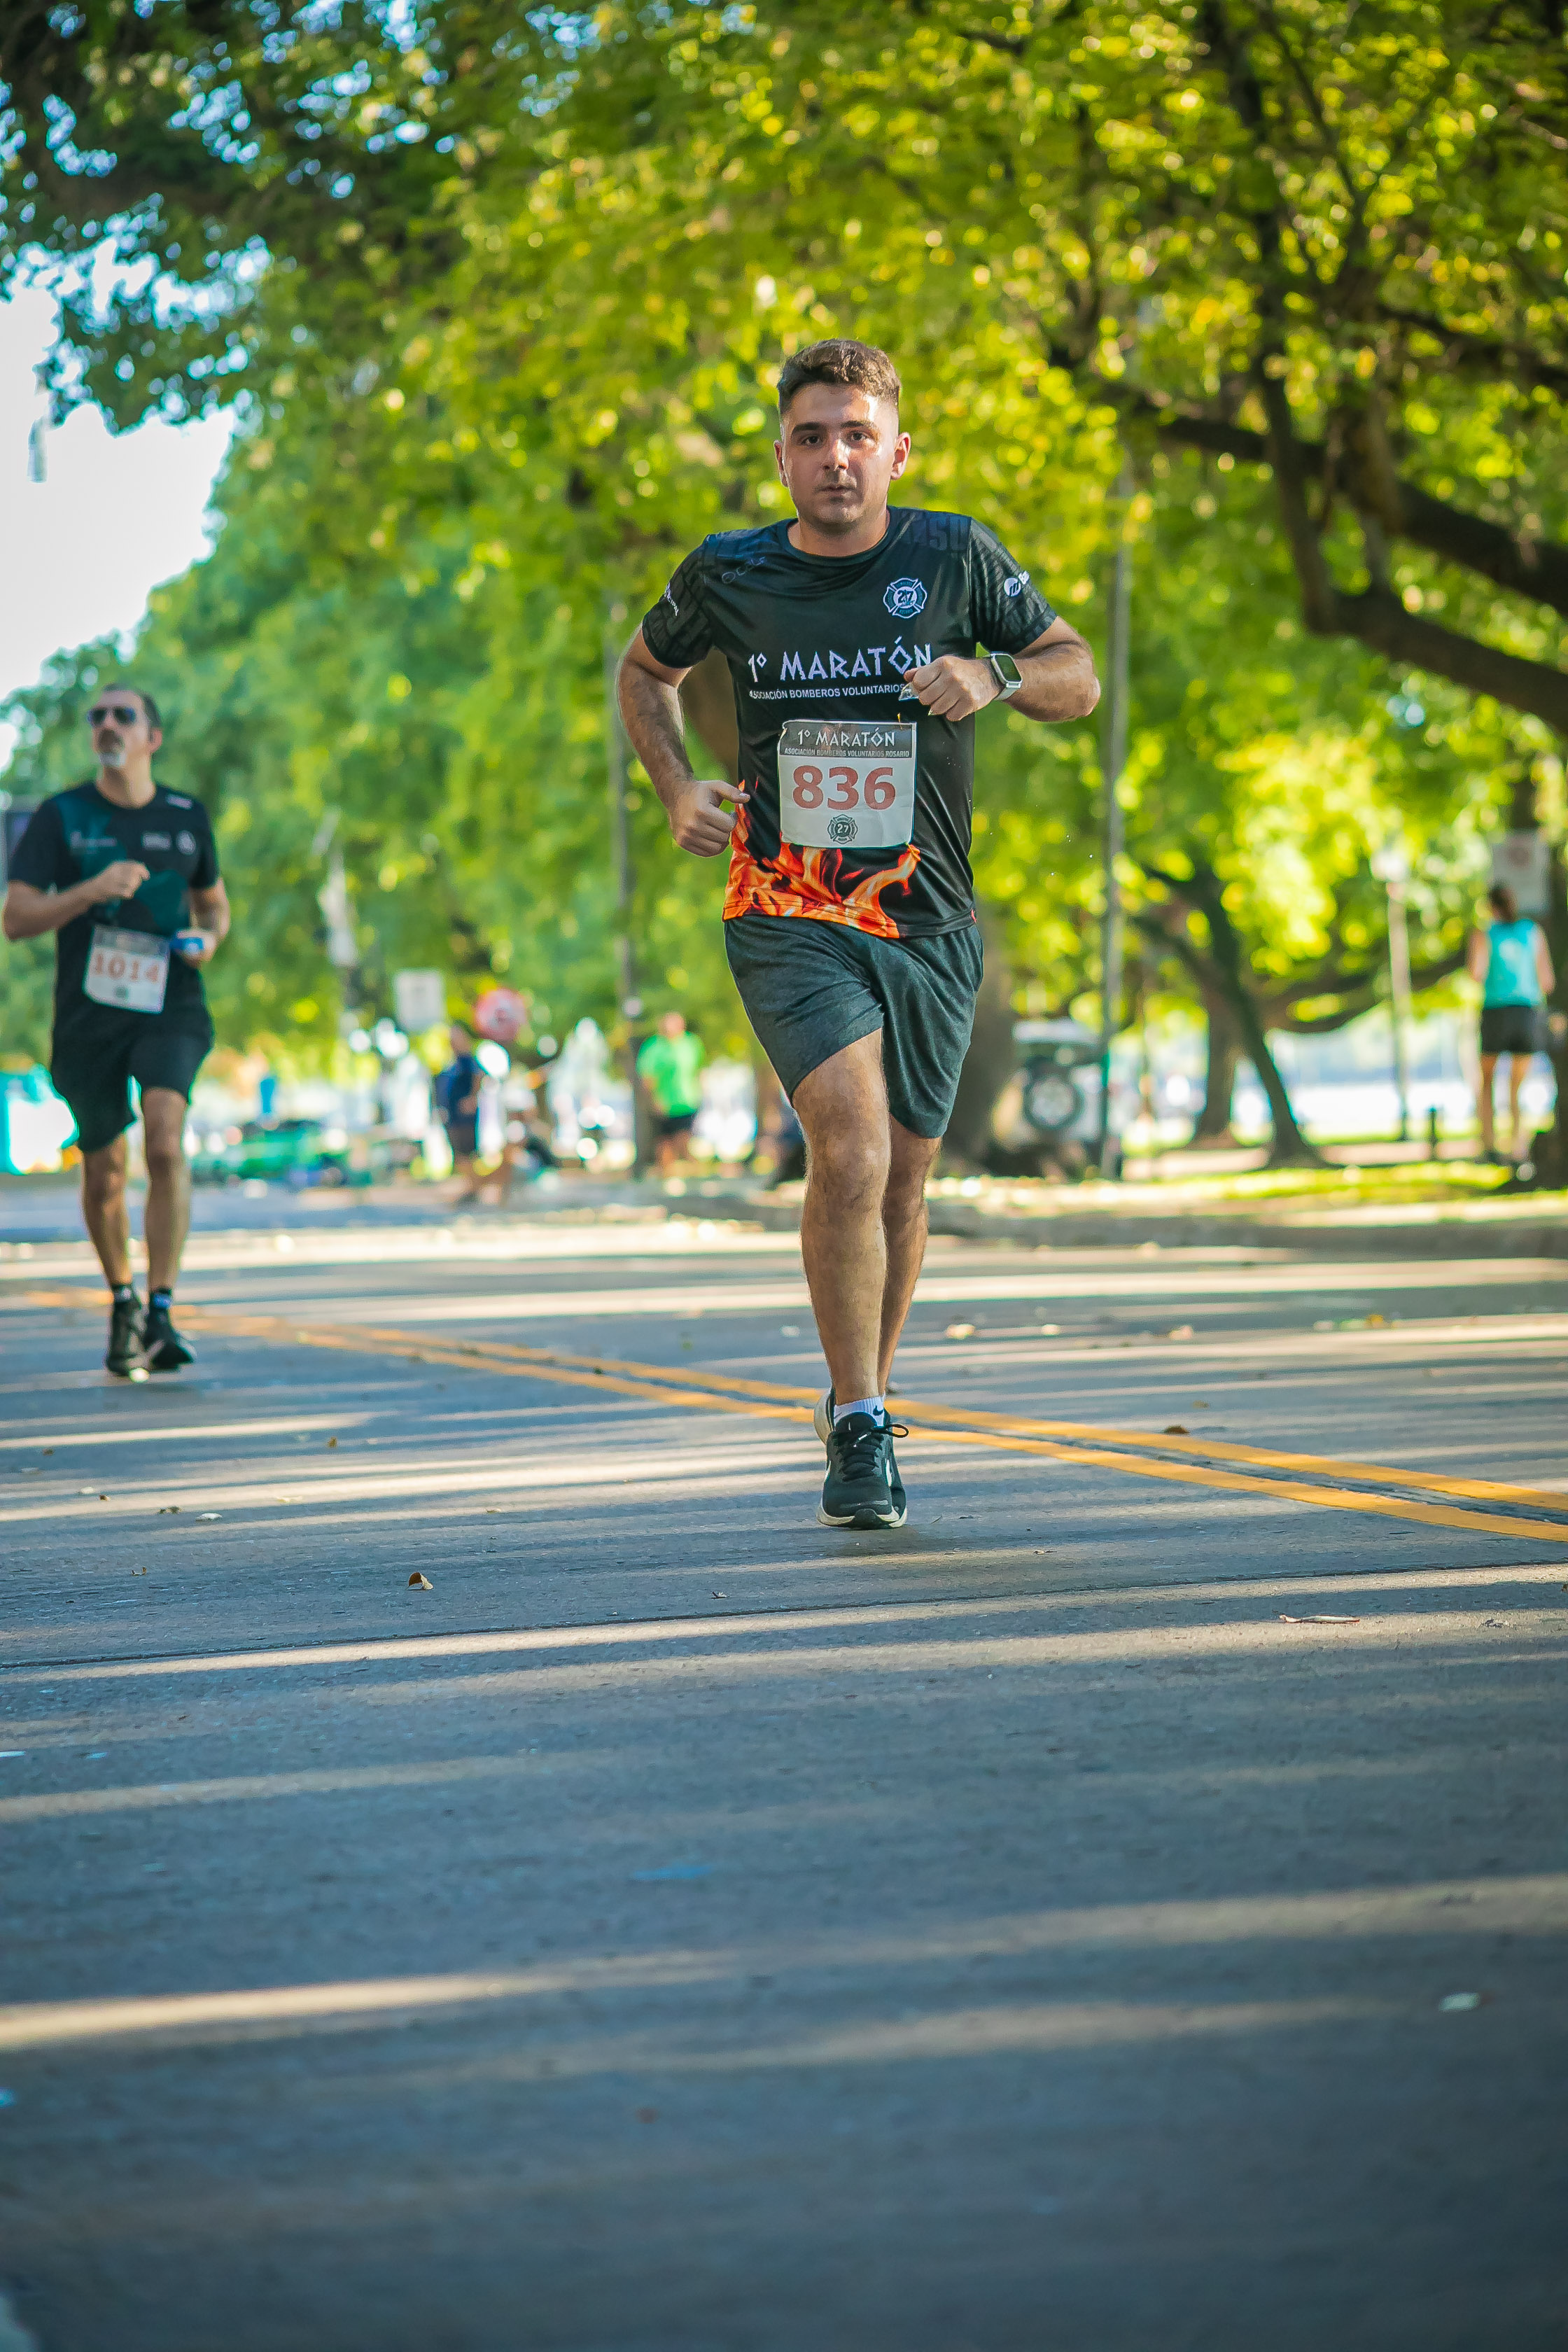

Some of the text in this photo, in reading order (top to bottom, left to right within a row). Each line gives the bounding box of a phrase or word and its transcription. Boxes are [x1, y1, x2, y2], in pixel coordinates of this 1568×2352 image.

[897, 589, 914, 603] 27
[780, 635, 932, 681] MARATÓN
[789, 688, 841, 699] BOMBEROS
[816, 727, 895, 747] MARATÓN
[784, 748, 816, 756] ASOCIACIÓN
[792, 765, 896, 811] 836
[837, 823, 849, 834] 27
[95, 953, 160, 983] 1014
